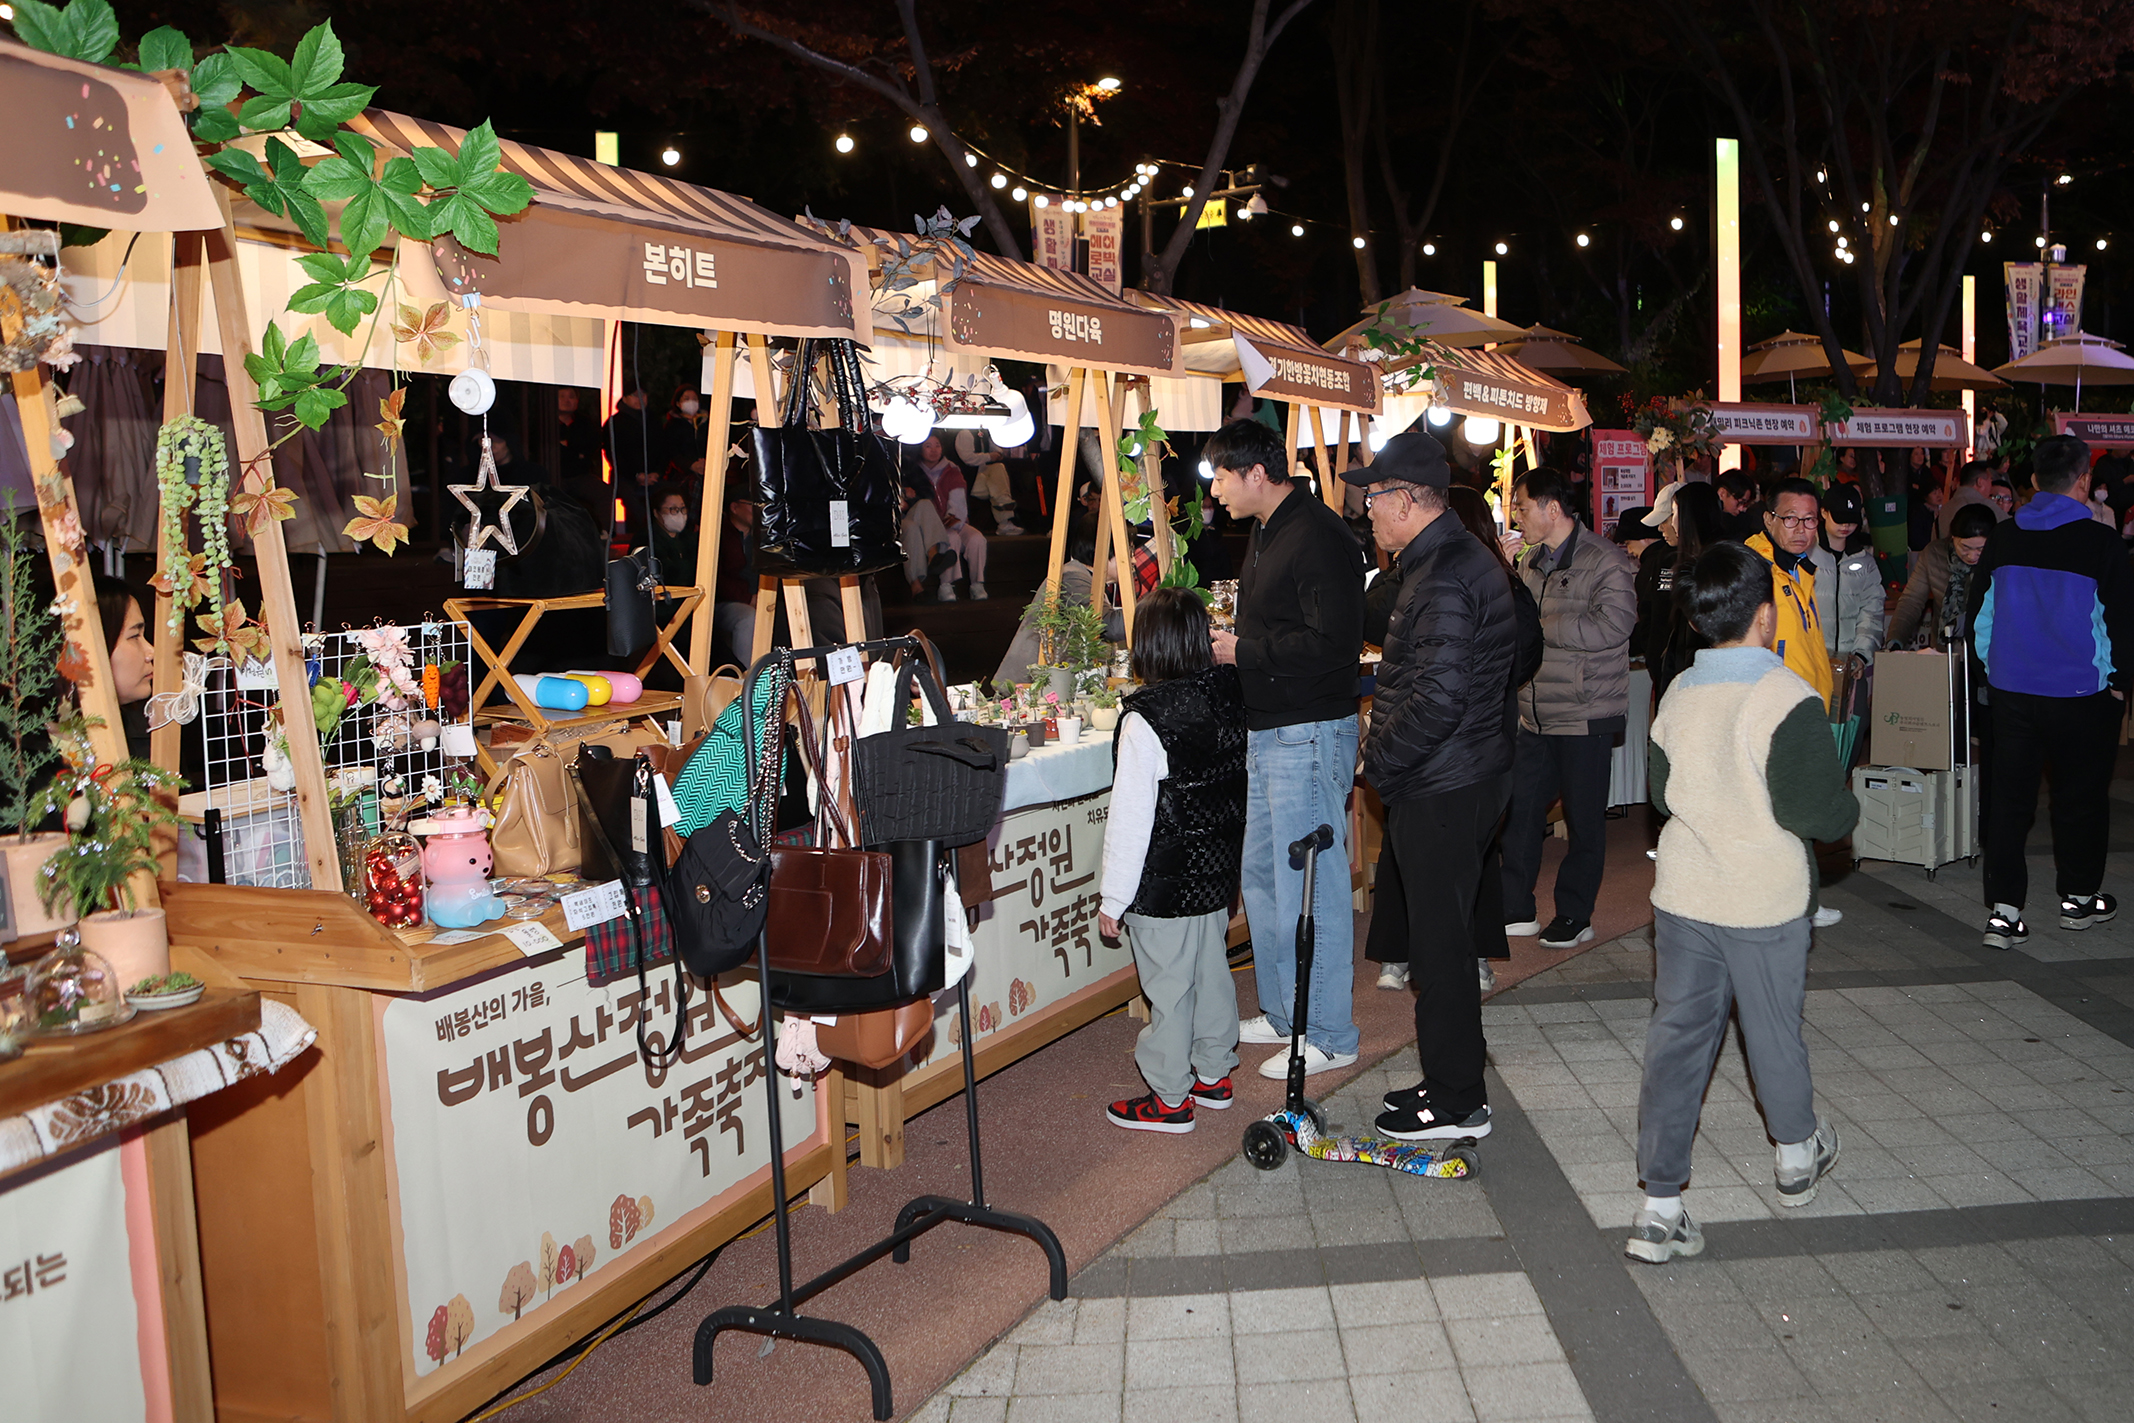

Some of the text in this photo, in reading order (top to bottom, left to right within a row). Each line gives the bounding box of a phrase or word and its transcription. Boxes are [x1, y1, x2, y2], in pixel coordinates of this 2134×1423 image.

[643, 242, 718, 289] 본히트
[1048, 310, 1102, 345] 명원다육
[1463, 381, 1549, 415] 편백&피톤치드 방향제
[1764, 419, 1779, 430] 현장
[1780, 419, 1795, 431] 예약
[1856, 422, 1936, 435] 체험 프로그램 현장 예약
[435, 980, 551, 1043] 배봉산의 가을,
